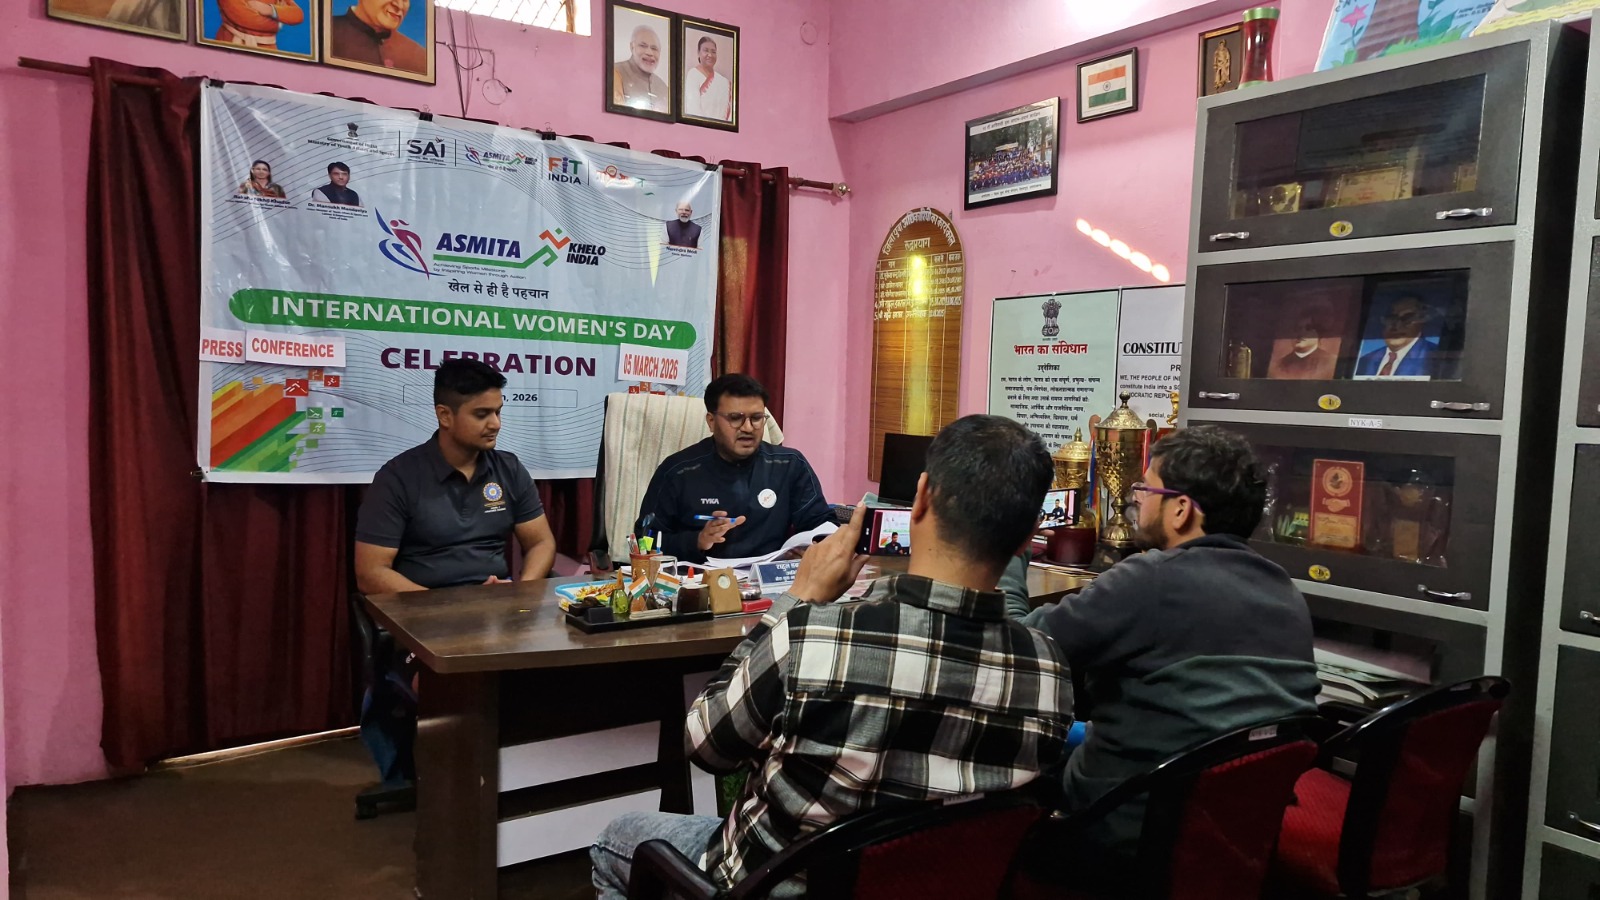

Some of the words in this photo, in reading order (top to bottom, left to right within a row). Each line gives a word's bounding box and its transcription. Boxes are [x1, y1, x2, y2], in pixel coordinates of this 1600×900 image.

[407, 140, 446, 158] SAI
[548, 173, 582, 185] INDIA
[436, 233, 521, 259] ASMITA
[568, 243, 606, 256] KHELO
[566, 253, 599, 266] INDIA
[448, 279, 470, 293] खेल
[473, 281, 483, 294] से
[486, 282, 498, 298] ही
[501, 282, 510, 298] है
[512, 287, 549, 300] पहचान
[271, 296, 506, 330] INTERNATIONAL
[513, 313, 627, 338] WOMEN'S
[633, 323, 676, 341] DAY
[201, 338, 243, 358] PRESS
[251, 338, 334, 358] CONFERENCE
[1014, 344, 1034, 355] भारत
[1037, 345, 1049, 354] का
[1052, 340, 1088, 354] संविधान
[1123, 342, 1182, 354] CONSTITU
[623, 353, 632, 375] 05
[633, 354, 659, 378] MARCH
[660, 357, 679, 380] 2026
[512, 393, 538, 402] 2026
[1350, 419, 1382, 428] NYK-A-5
